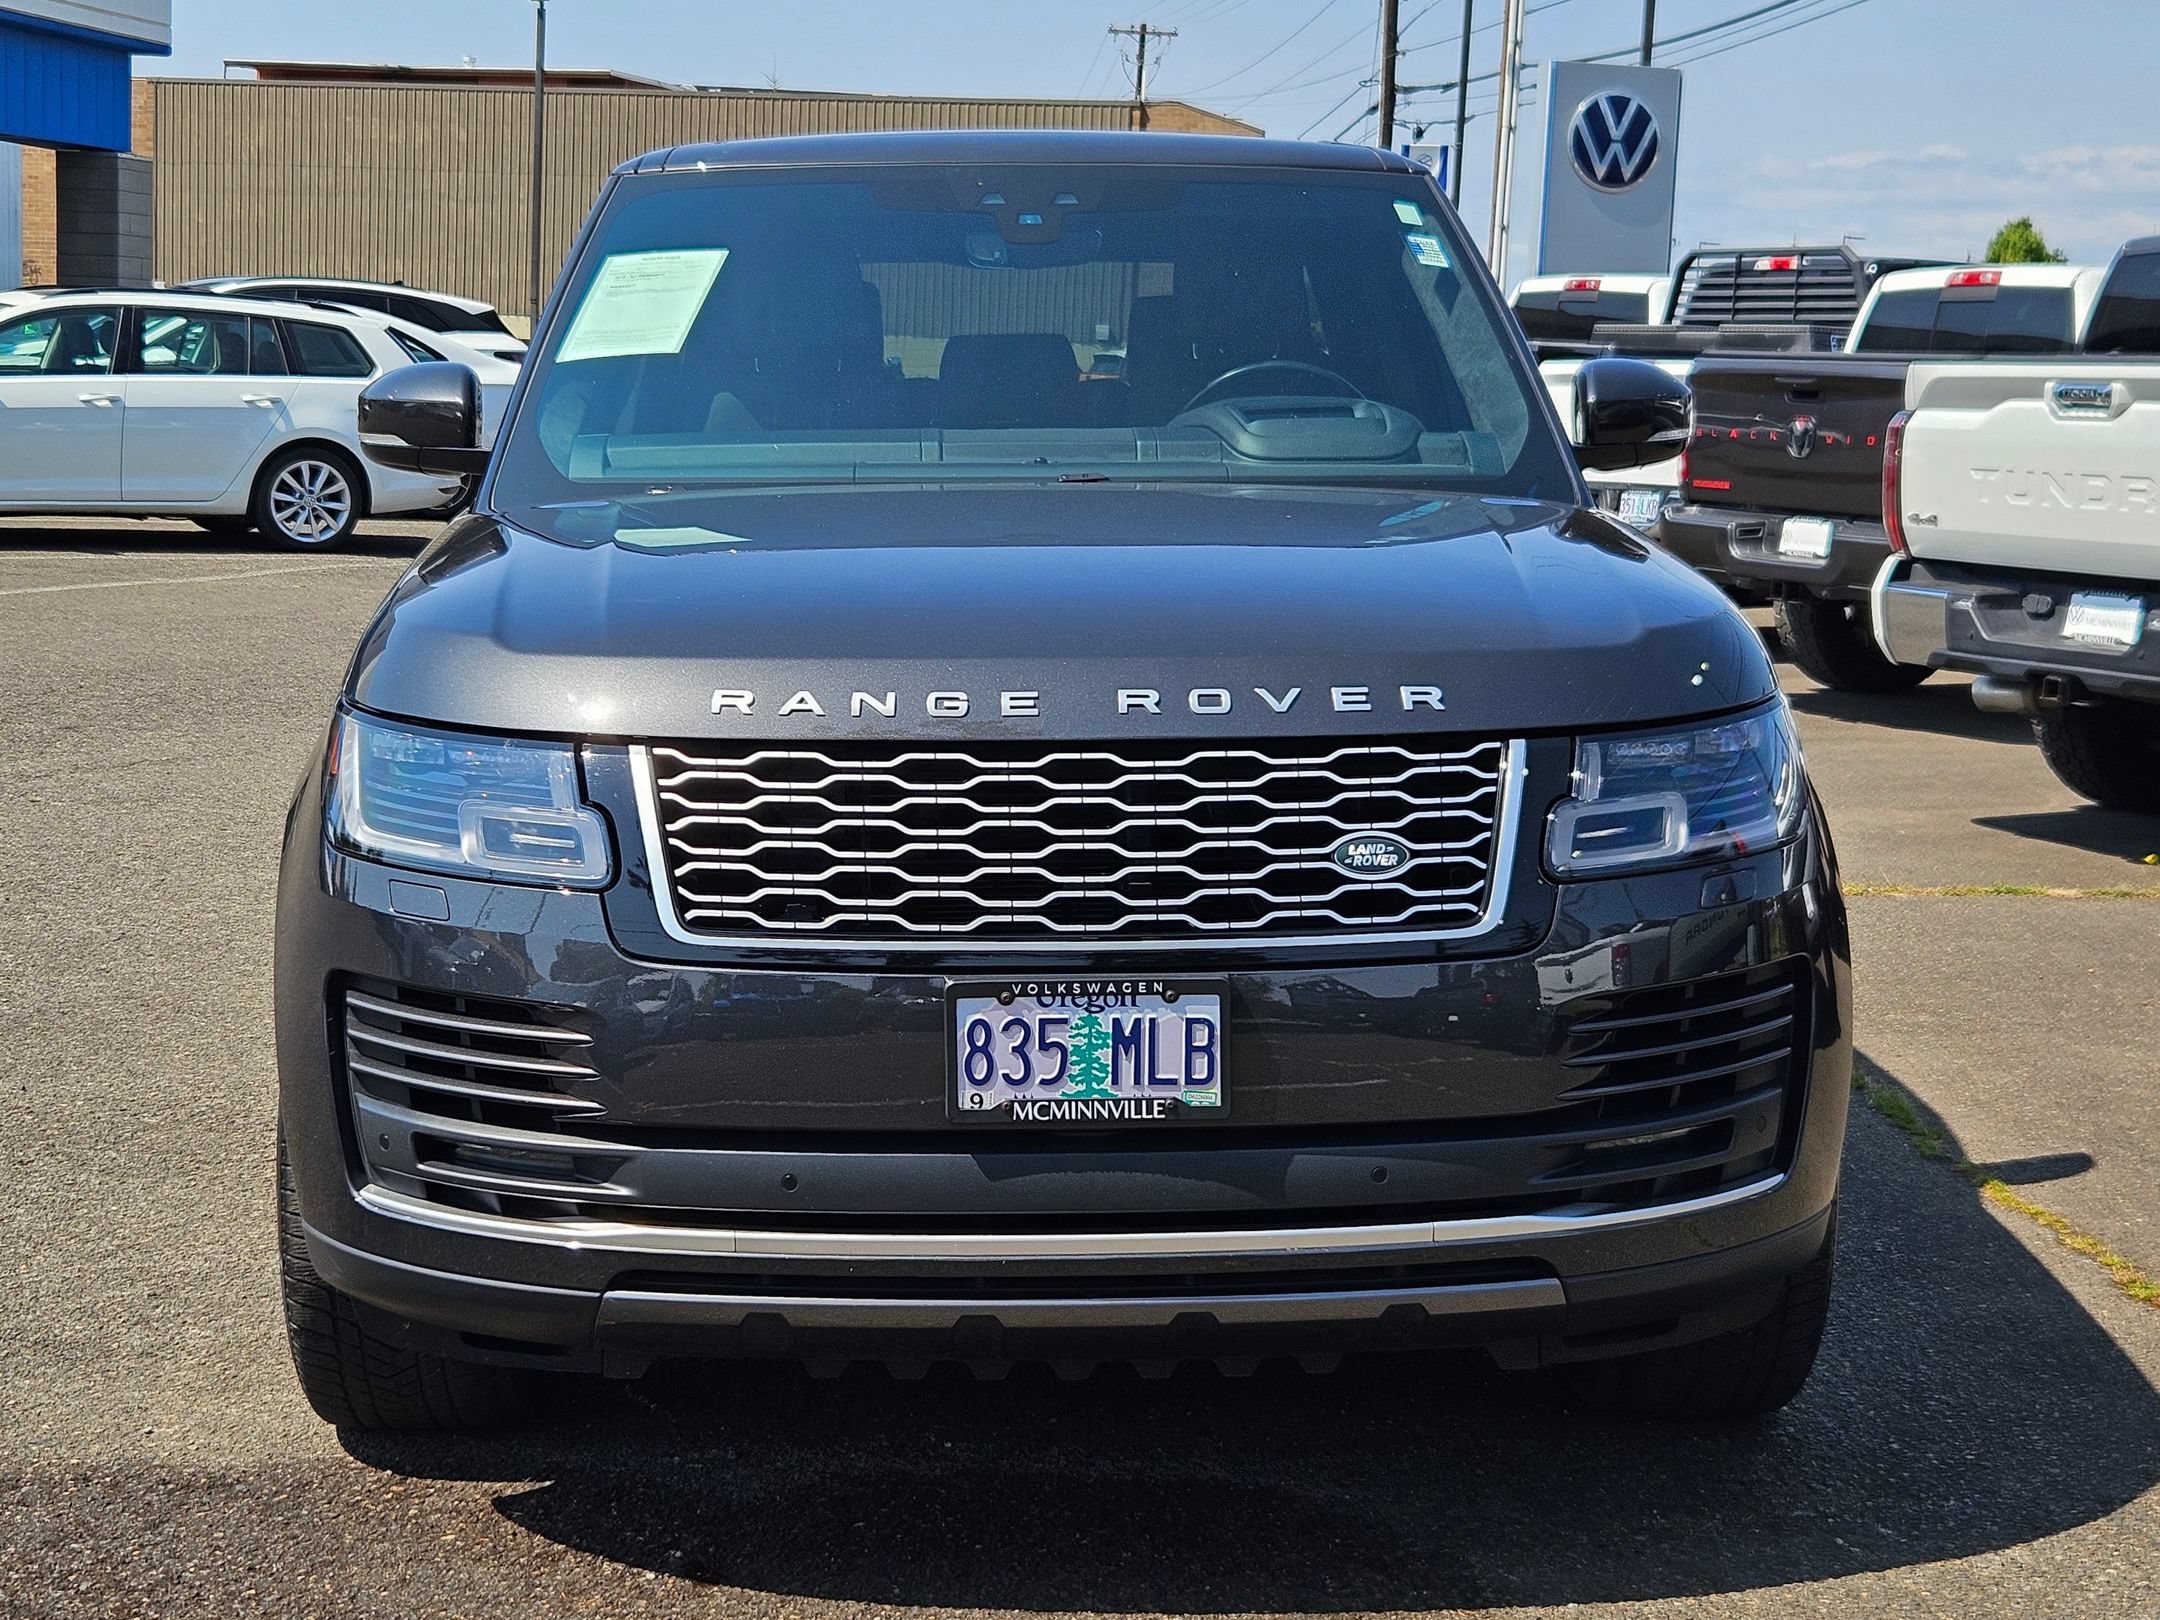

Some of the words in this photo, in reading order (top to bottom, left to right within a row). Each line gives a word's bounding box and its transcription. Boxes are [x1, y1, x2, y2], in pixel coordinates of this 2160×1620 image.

[1574, 95, 1658, 184] VW
[1696, 428, 1777, 440] BLACK
[1826, 435, 1878, 446] WID
[711, 689, 1040, 717] RANGE
[1117, 686, 1447, 714] ROVER
[1348, 843, 1386, 856] LAND
[1352, 854, 1399, 867] ROVER
[1011, 981, 1164, 995] VOLKSWAGEN
[964, 1016, 1070, 1087] 835
[1110, 1016, 1216, 1087] MLB
[970, 1092, 984, 1109] 9
[1012, 1101, 1167, 1121] MCMINNVILLE
